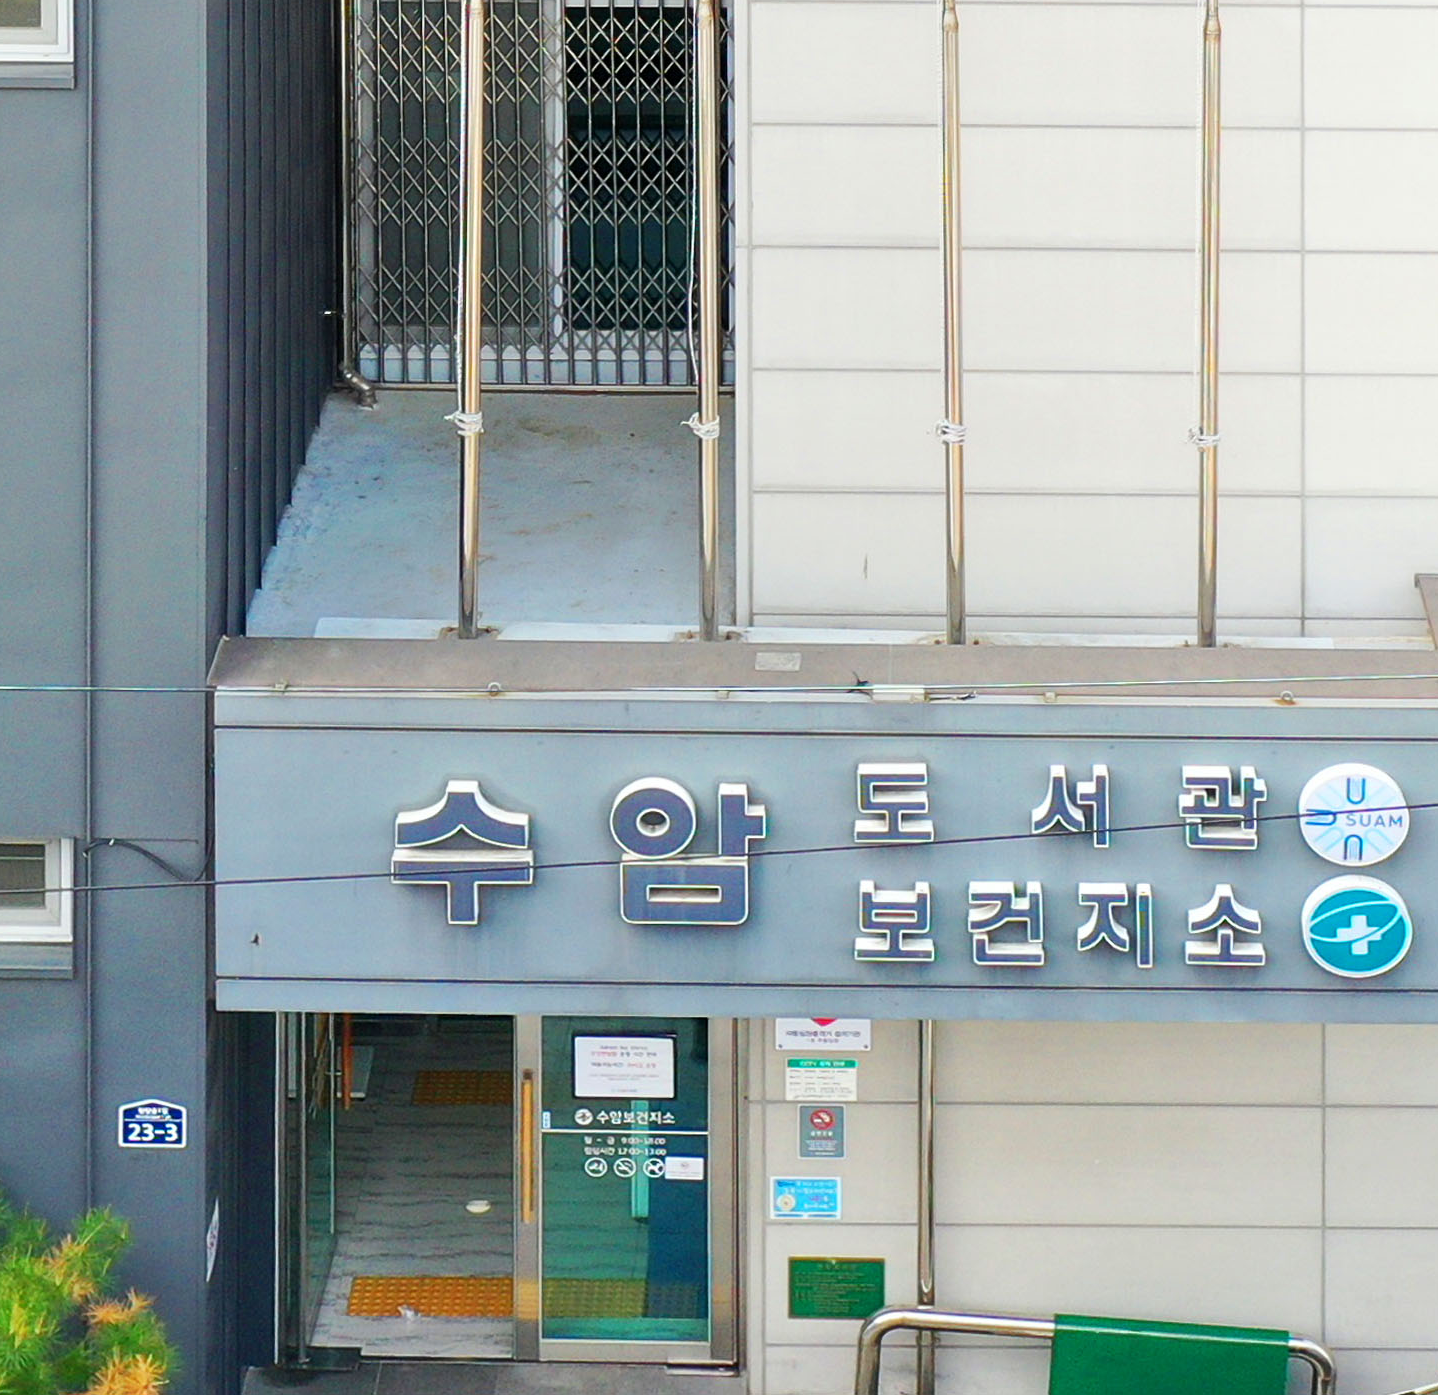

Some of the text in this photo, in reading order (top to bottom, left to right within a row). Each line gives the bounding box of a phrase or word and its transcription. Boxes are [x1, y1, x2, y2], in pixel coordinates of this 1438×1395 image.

[853, 761, 1268, 851] 도서관
[1345, 812, 1404, 829] SUAM
[390, 776, 768, 926] 수암
[853, 878, 1267, 968] 보건지소
[127, 1122, 179, 1142] 23-3
[596, 1109, 676, 1125] 수암보건지소
